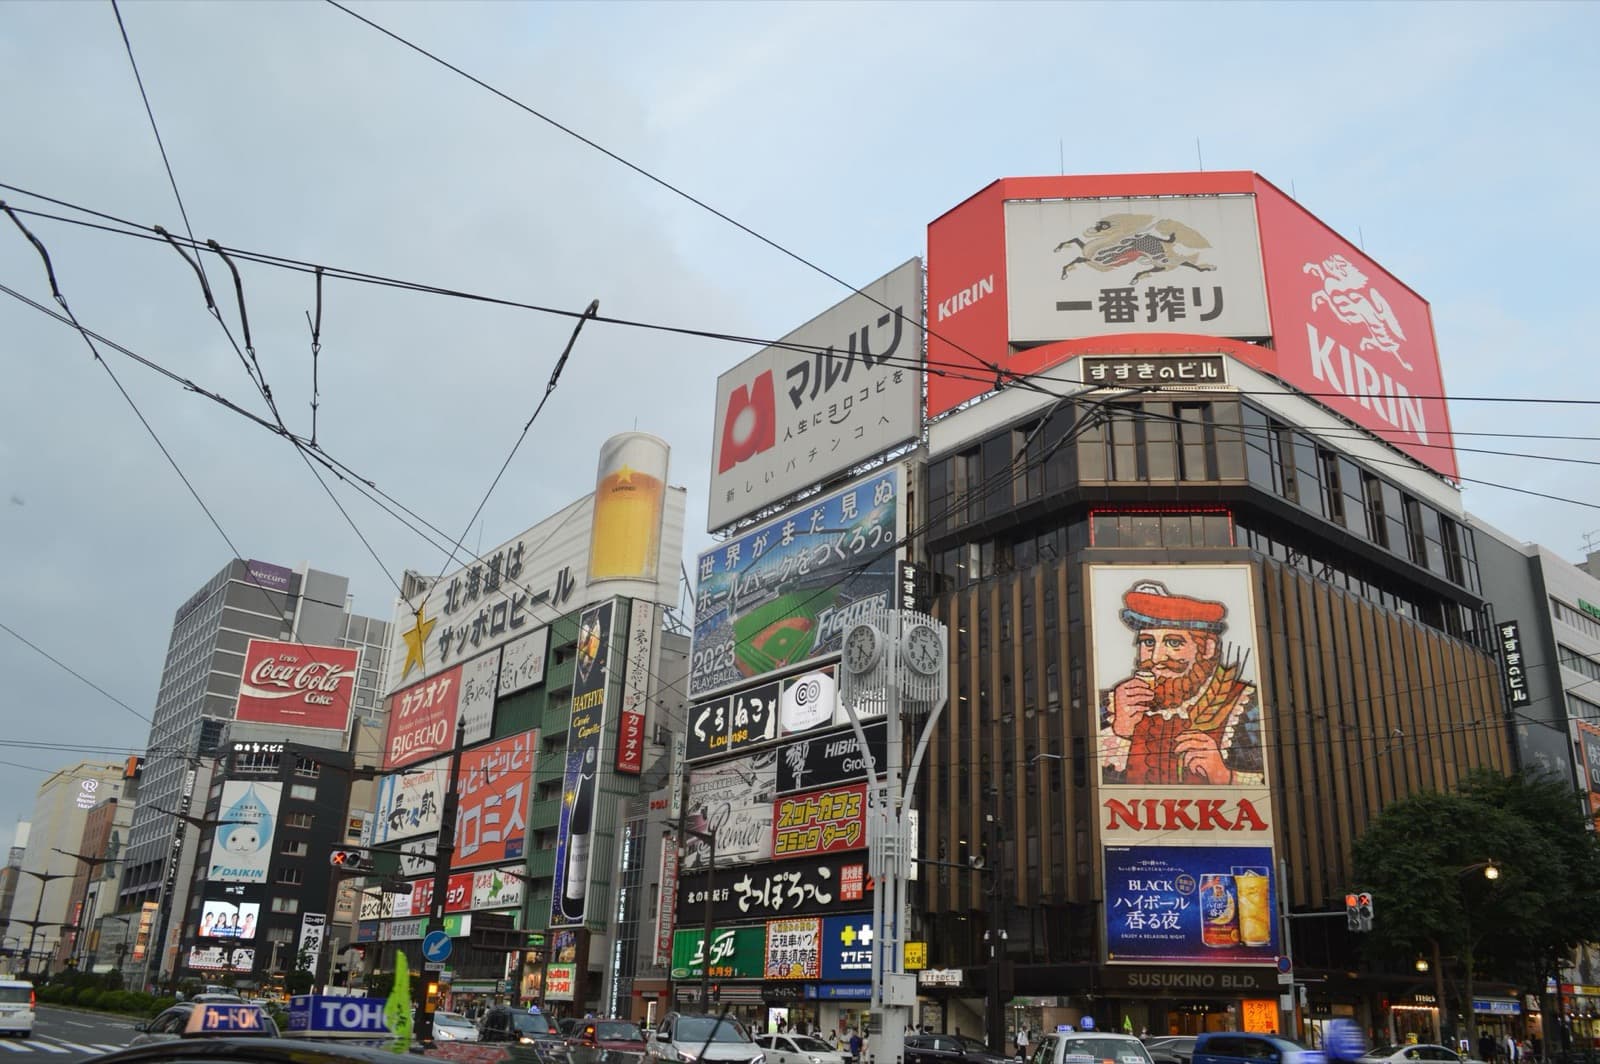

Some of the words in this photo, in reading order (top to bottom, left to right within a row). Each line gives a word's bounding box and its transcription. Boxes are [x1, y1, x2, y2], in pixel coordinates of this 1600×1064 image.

[937, 274, 994, 322] KIRIN
[1056, 286, 1224, 323] 一番搾り
[786, 305, 903, 411] マルハン
[1090, 362, 1217, 380] すすきのビル
[1304, 323, 1429, 446] KIRIN
[784, 370, 903, 442] 人生にヨロコビを
[726, 416, 889, 503] 新しいパチンコへ
[700, 480, 893, 580] 世界がまだ見ぬ
[250, 569, 287, 584] Mercure
[444, 541, 526, 615] 北海道は
[698, 518, 892, 612] ボールパークをつくろう。
[439, 566, 575, 662] サッポロビール
[251, 658, 343, 692] Coca-Cola
[692, 641, 736, 678] 2023
[1501, 625, 1526, 701] すすきのビル
[304, 692, 333, 706] Coke
[399, 678, 452, 719] カラオケ
[625, 714, 641, 762] カラオケ
[694, 698, 763, 741] くろねこ
[824, 738, 861, 758] HIBIK
[778, 793, 862, 829] ネットカフェ
[1104, 798, 1269, 831] NIKKA
[775, 825, 820, 856] コミック
[822, 820, 860, 850] ダーツ
[222, 868, 264, 878] DAIKIN
[733, 866, 832, 912] さっぽろっこ
[1128, 880, 1174, 891] BLACK
[1113, 894, 1190, 910] ハイボール
[1125, 910, 1181, 929] 香る夜
[1128, 973, 1214, 987] SUSUKINO
[1221, 975, 1260, 988] BLD.
[206, 1006, 260, 1029] カードOK
[321, 1002, 391, 1029] TOH
